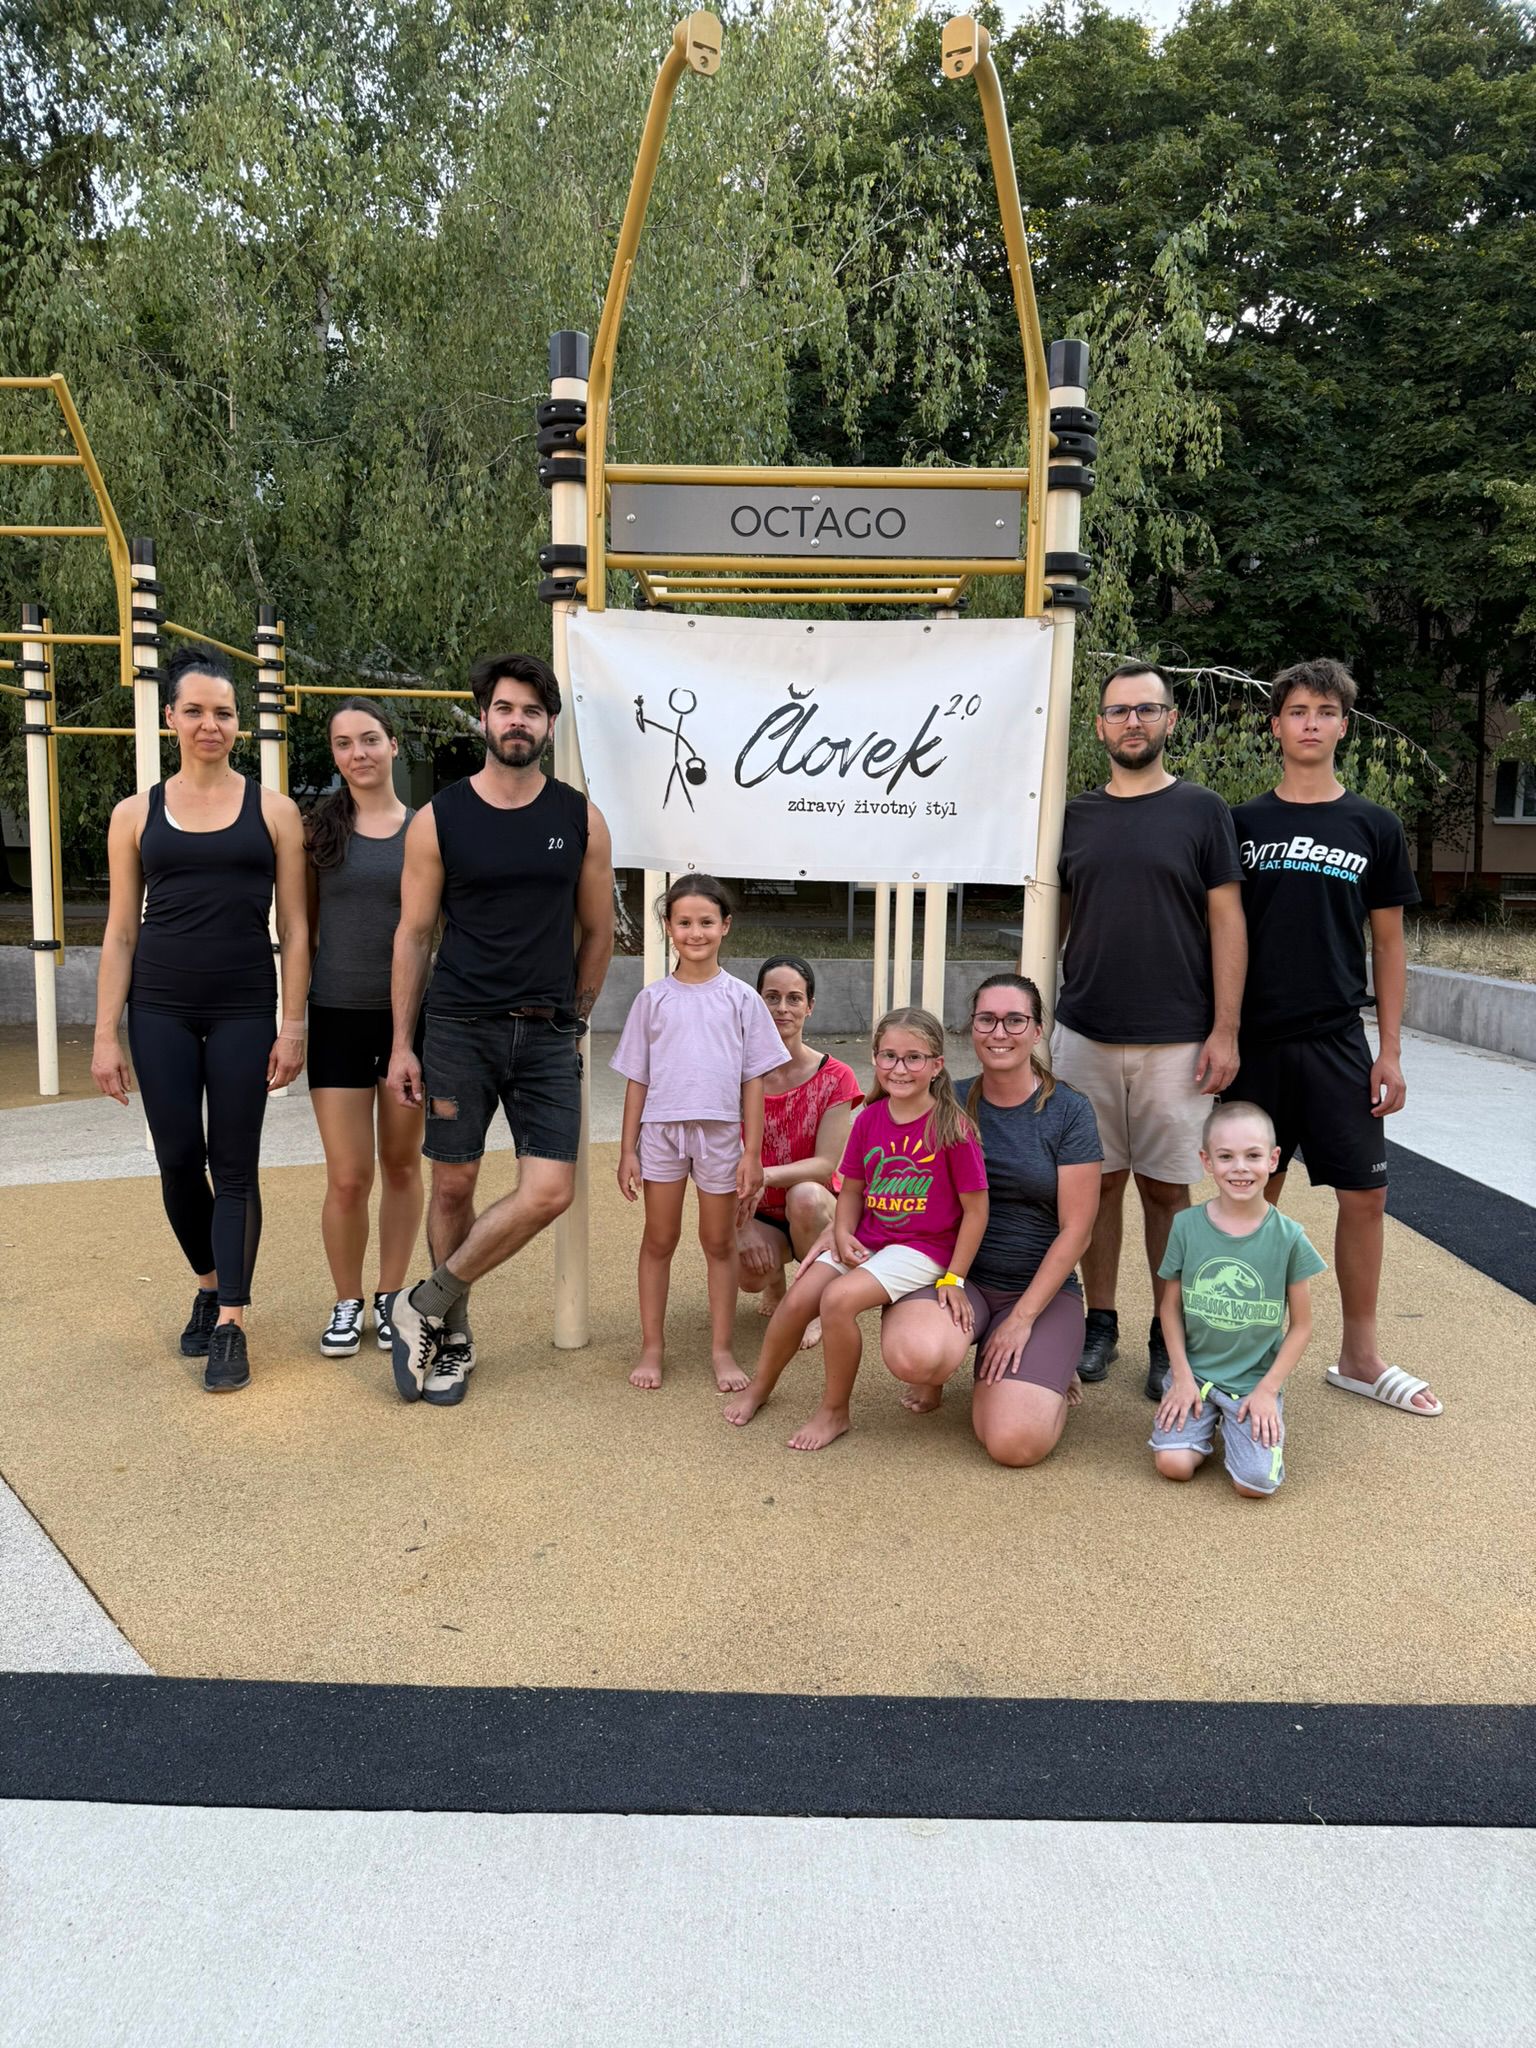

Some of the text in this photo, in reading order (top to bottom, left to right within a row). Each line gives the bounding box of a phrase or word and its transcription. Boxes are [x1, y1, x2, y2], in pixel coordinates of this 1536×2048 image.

[730, 505, 906, 539] OCTAGO
[735, 683, 982, 795] Človek 2.0
[787, 798, 957, 819] zdravý životný štýl
[548, 837, 564, 850] 2.0
[1240, 836, 1368, 874] GymBeam
[1259, 859, 1359, 884] EAT. BURN. GROW.
[867, 1195, 928, 1212] DANCE
[1230, 1300, 1279, 1321] WORLD
